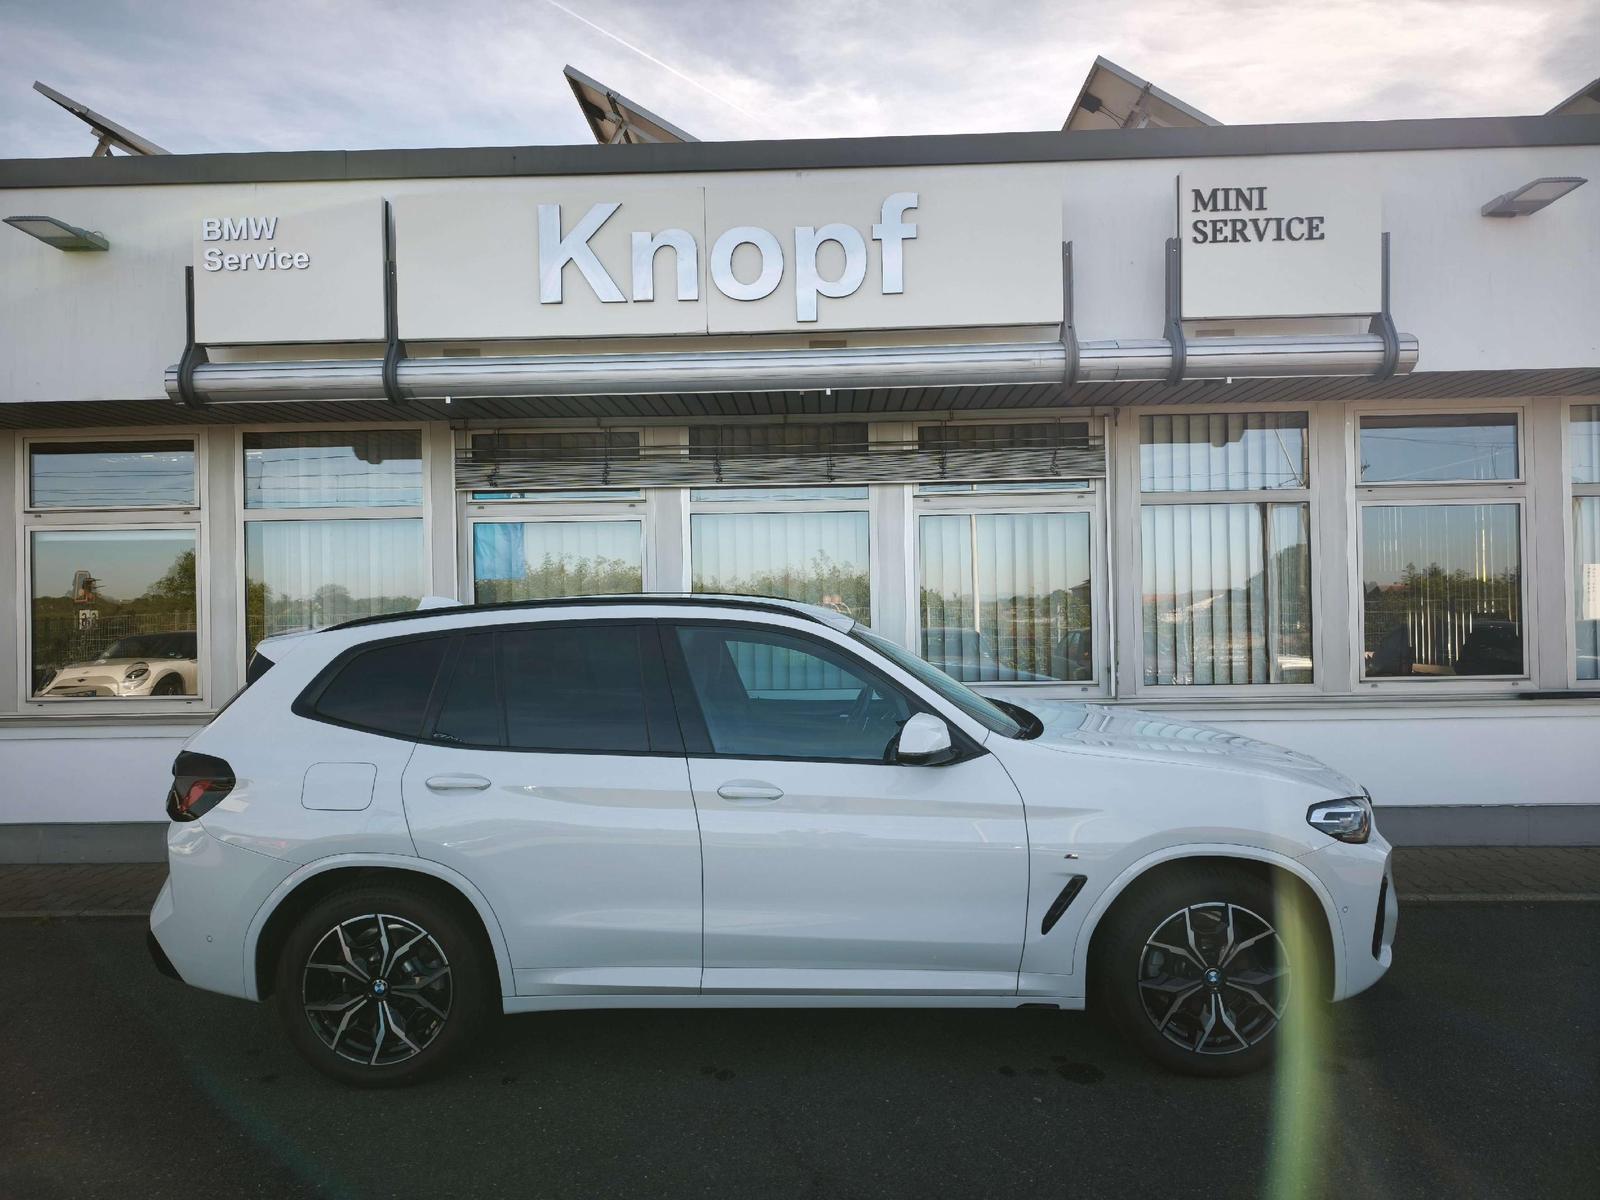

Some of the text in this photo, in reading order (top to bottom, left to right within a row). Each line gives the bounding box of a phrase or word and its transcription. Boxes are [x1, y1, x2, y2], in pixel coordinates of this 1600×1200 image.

[1191, 187, 1268, 212] MINI
[202, 216, 278, 241] BMW
[1192, 216, 1325, 244] SERVICE
[203, 247, 310, 272] Service
[537, 192, 919, 322] Knopf
